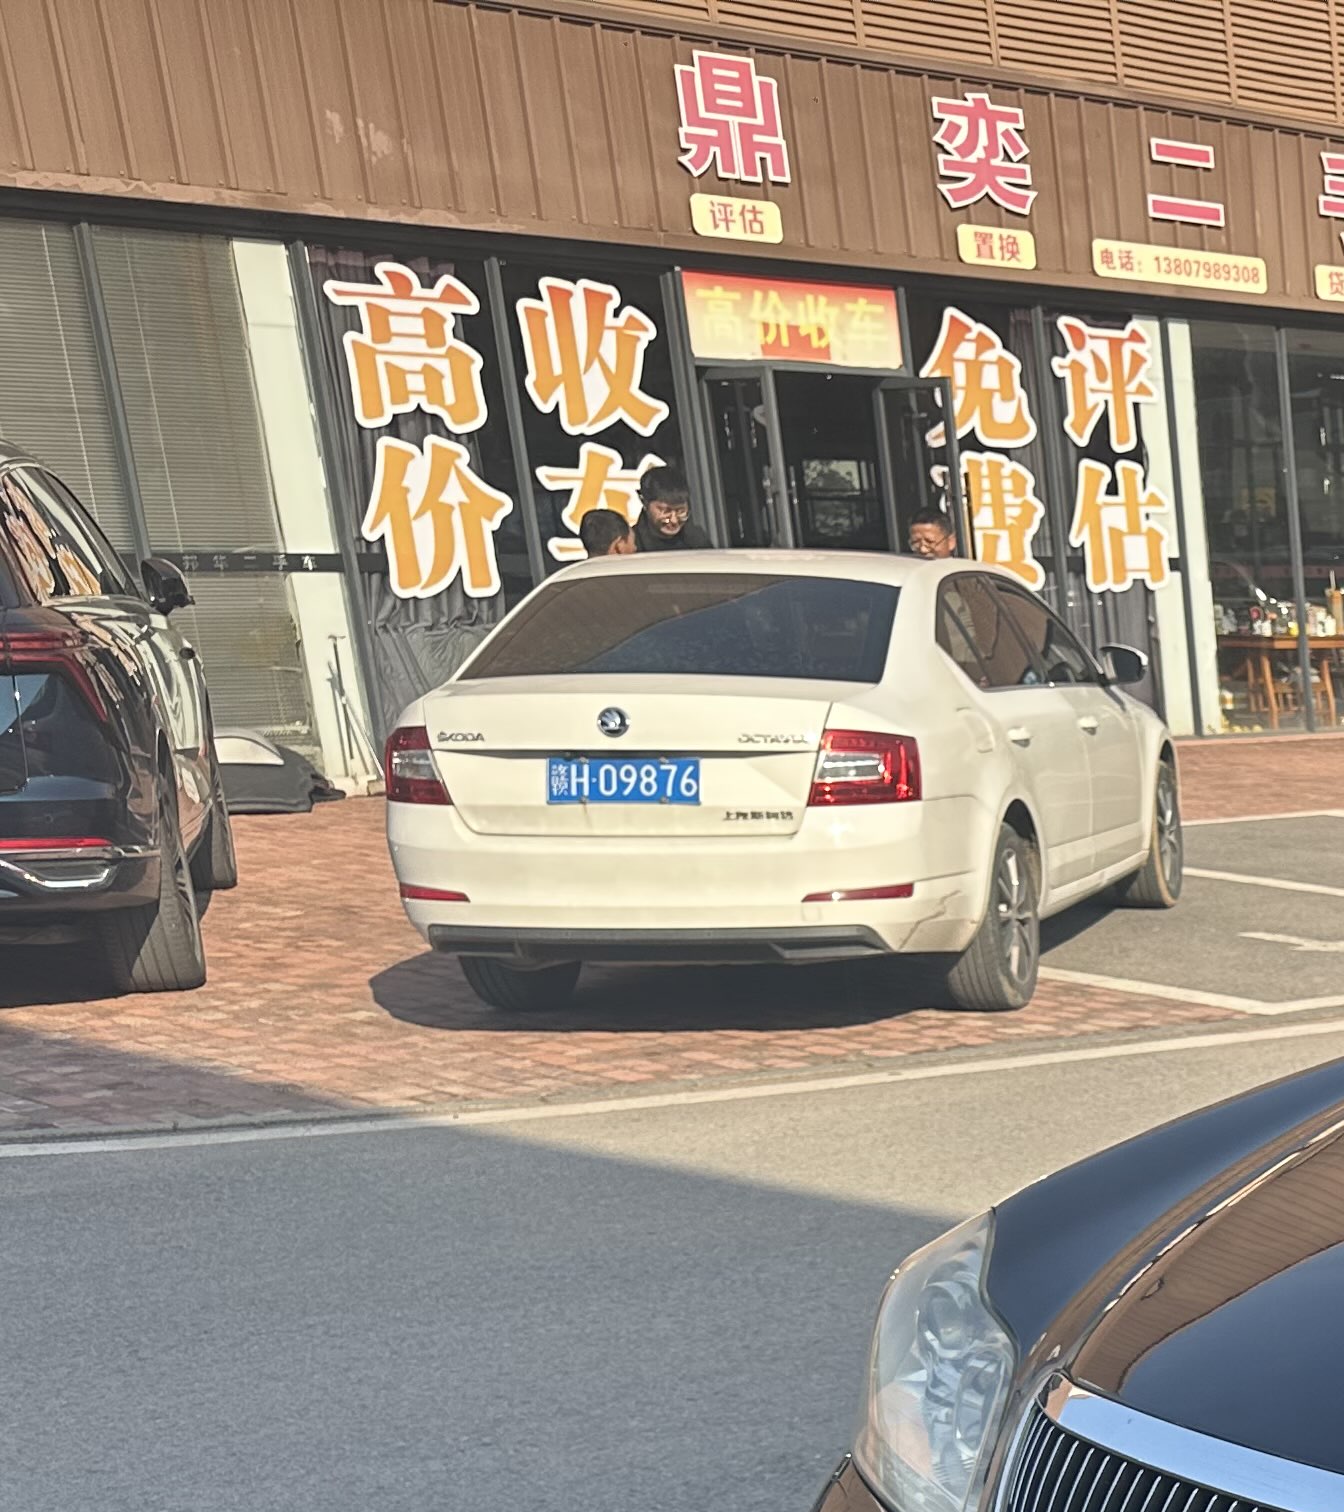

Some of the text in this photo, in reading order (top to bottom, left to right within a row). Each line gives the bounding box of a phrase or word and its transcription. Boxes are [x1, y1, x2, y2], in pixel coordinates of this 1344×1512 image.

[709, 199, 765, 236] 评估
[973, 231, 1022, 262] 置换
[695, 285, 890, 353] 高价收车
